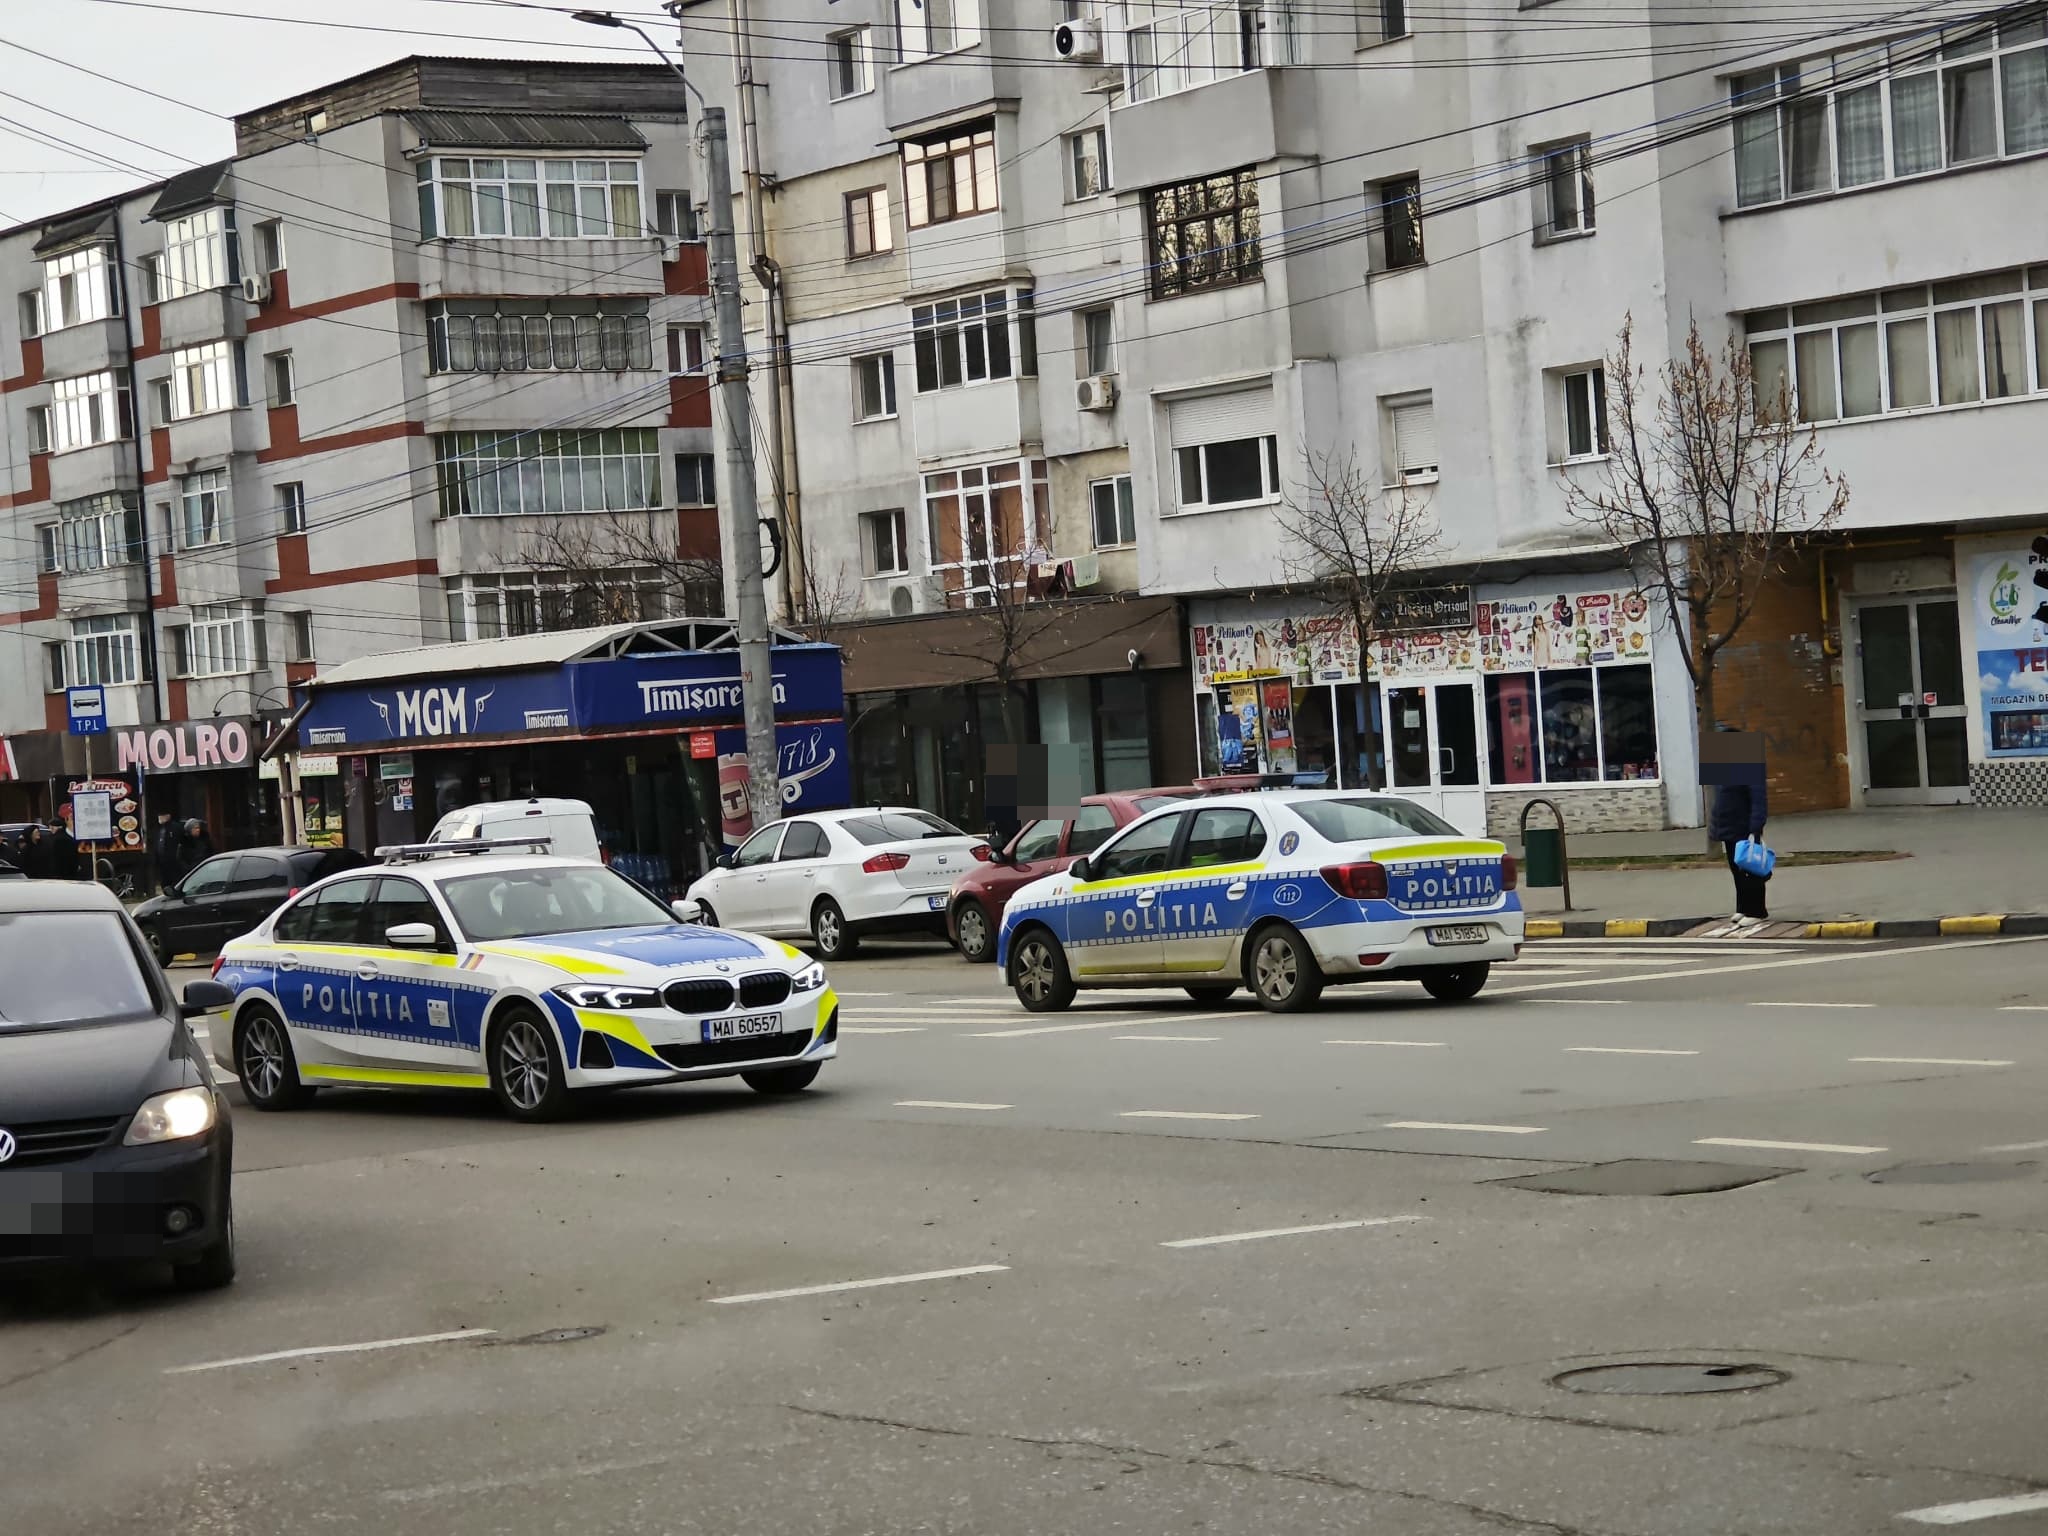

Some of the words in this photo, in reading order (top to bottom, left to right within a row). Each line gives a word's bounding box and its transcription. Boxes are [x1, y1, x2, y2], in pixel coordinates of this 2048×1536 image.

[1217, 625, 1245, 639] Pelikan
[396, 687, 469, 737] MGM
[1991, 695, 2035, 705] MAGAZIN
[117, 722, 248, 772] MOLRO
[777, 727, 822, 773] 1718
[1282, 890, 1297, 902] 112
[1407, 874, 1495, 899] POLITIA
[1105, 901, 1219, 933] POLITIA
[1435, 927, 1453, 941] MAI
[1454, 926, 1484, 939] 51854
[303, 983, 415, 1023] POLITIA
[712, 1020, 735, 1041] MAI
[738, 1014, 778, 1035] 60557
